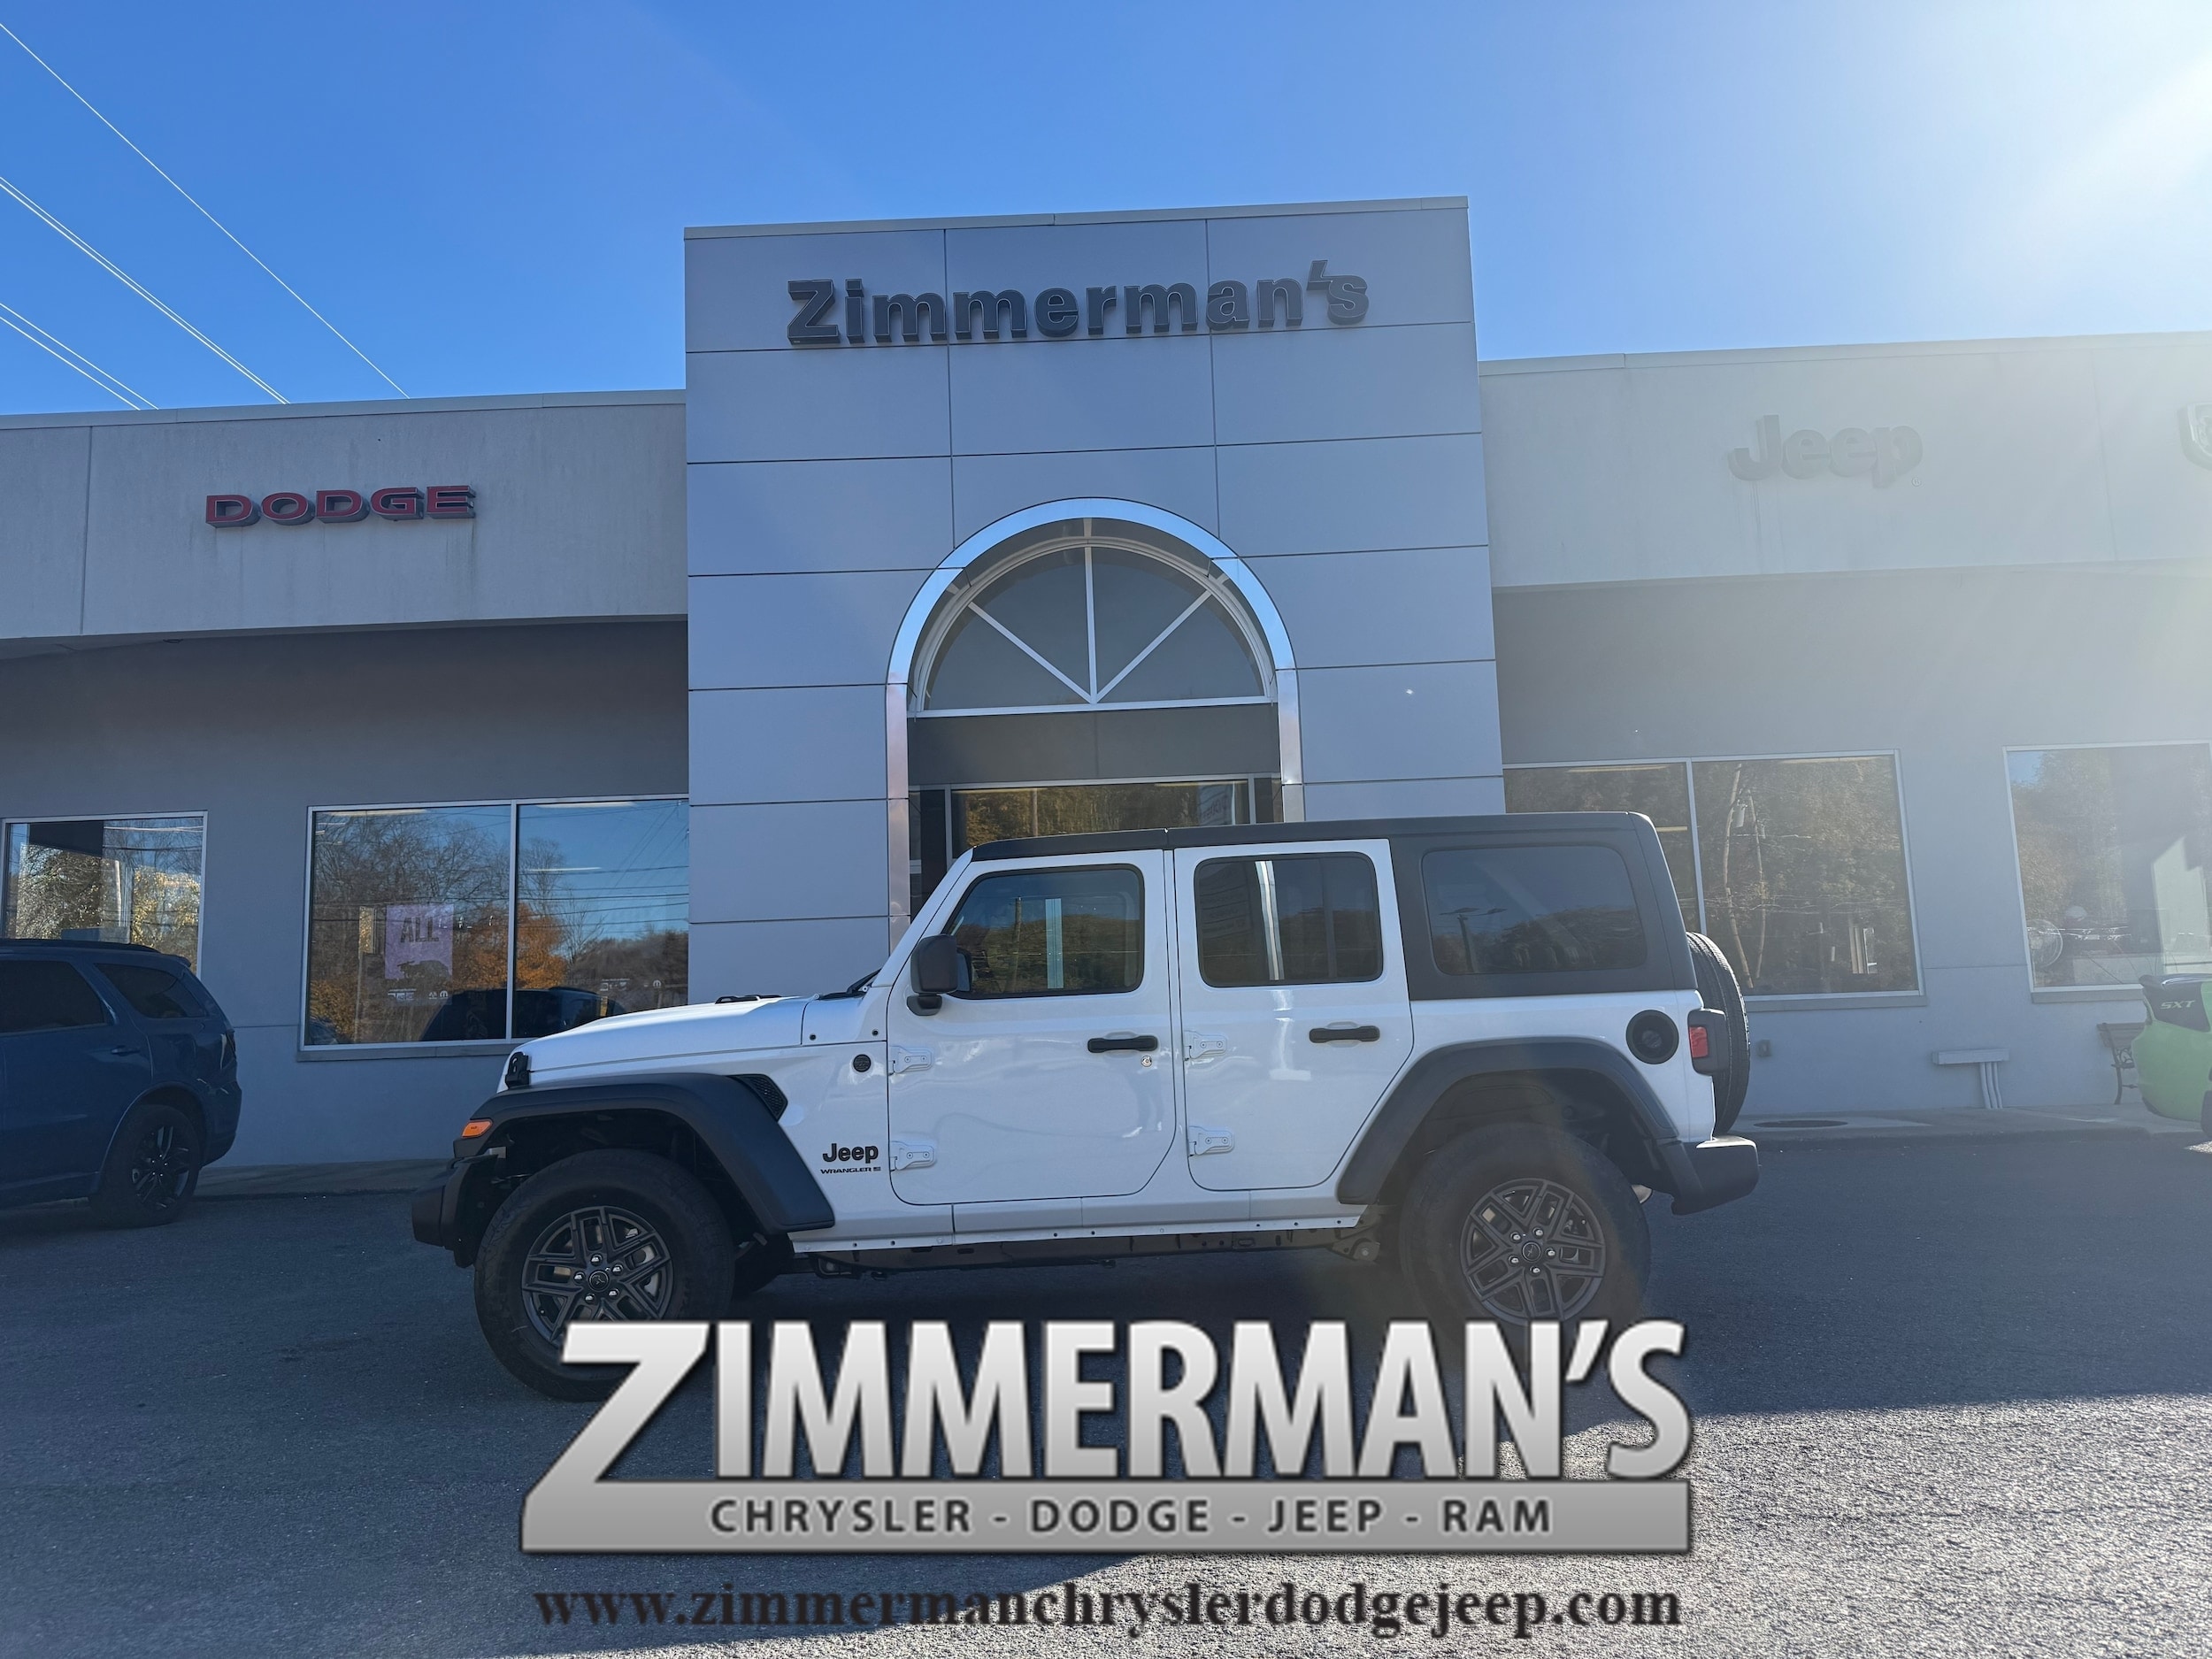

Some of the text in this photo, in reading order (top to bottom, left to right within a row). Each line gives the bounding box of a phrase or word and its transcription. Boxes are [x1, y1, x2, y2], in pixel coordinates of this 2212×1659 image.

[787, 259, 1370, 344] Zimmerman's
[1727, 413, 1924, 488] Jeep
[205, 485, 476, 528] DODGE
[400, 915, 440, 943] ALL
[2159, 999, 2196, 1010] SXT
[822, 1142, 879, 1164] Jeep
